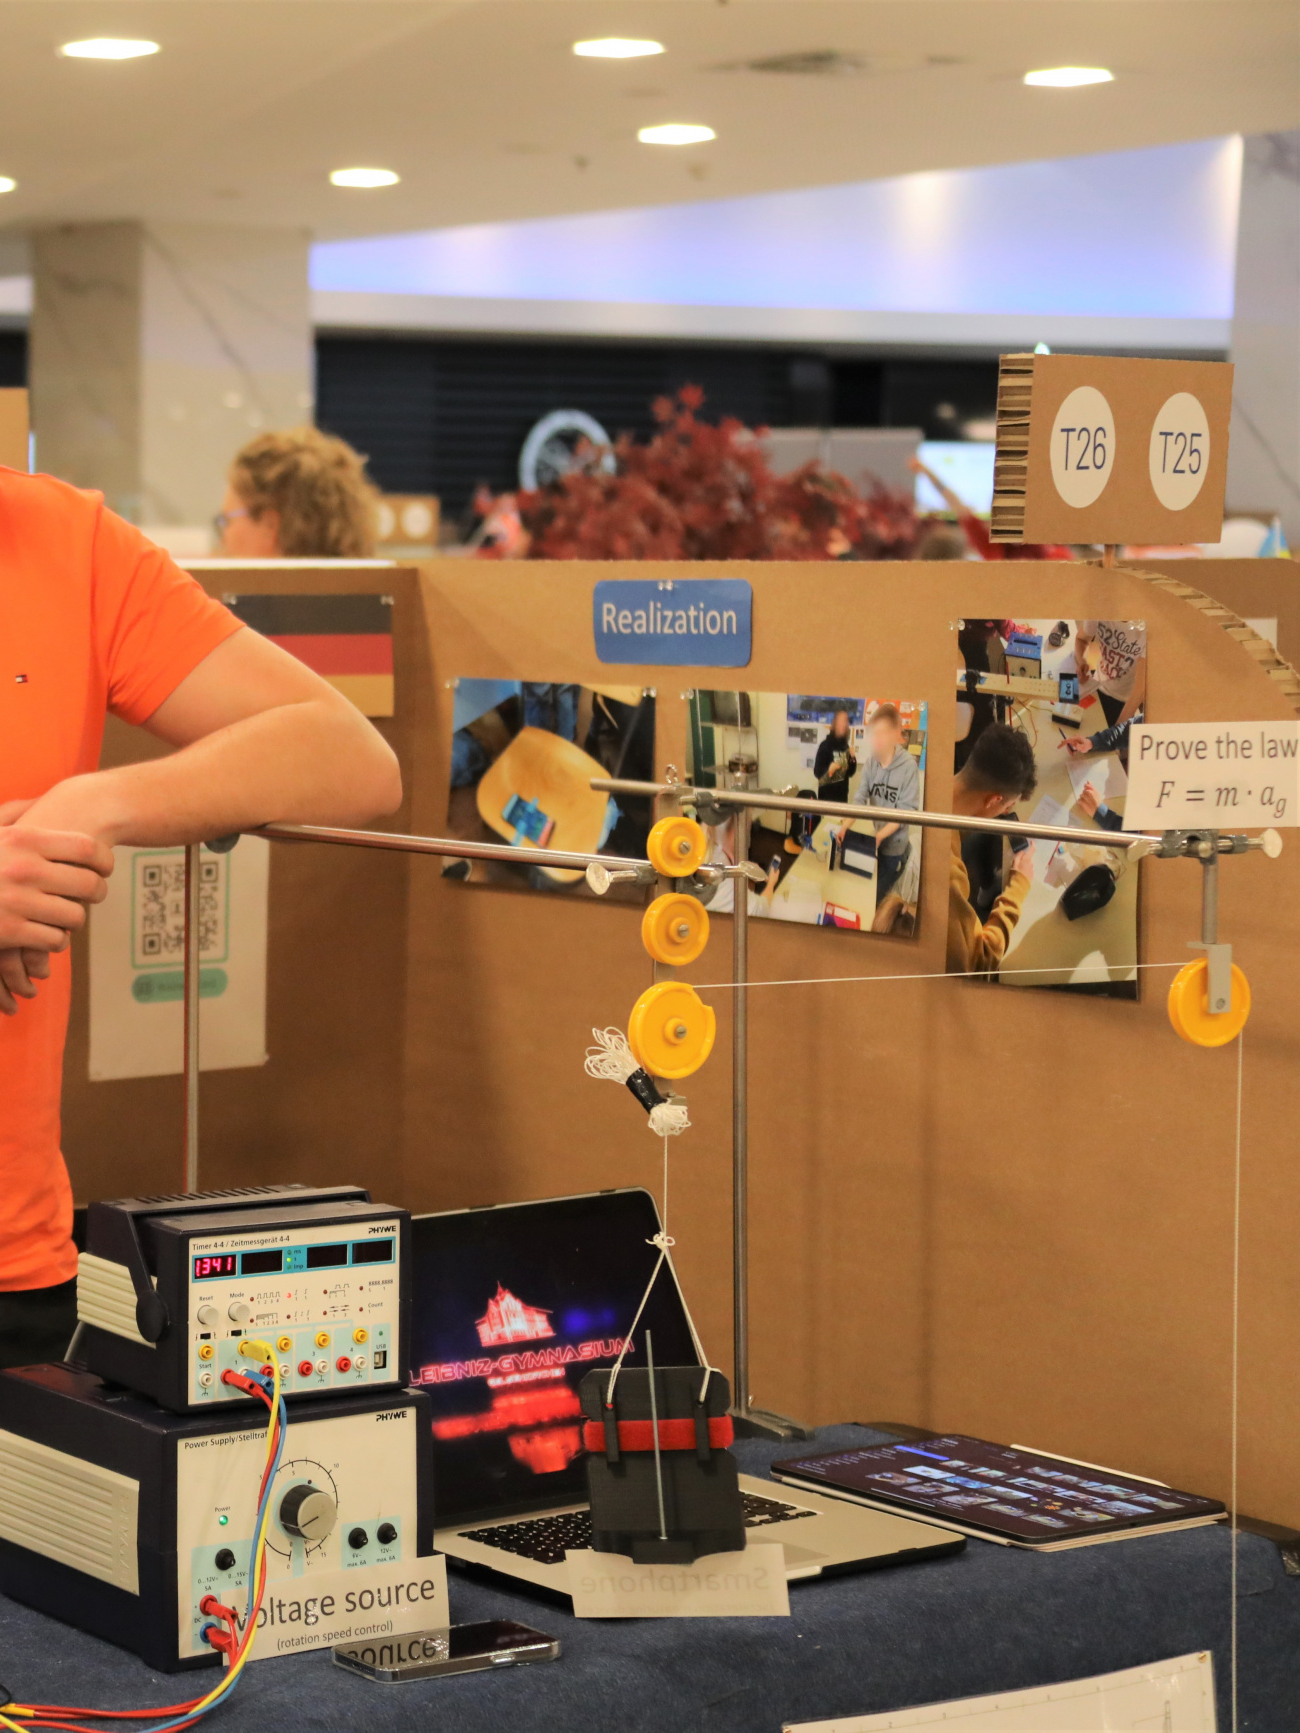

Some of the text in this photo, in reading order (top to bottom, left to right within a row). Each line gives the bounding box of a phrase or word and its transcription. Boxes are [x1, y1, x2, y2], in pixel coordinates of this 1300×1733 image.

[1060, 427, 1107, 471] T26
[1159, 431, 1203, 475] T25
[602, 600, 737, 635] Realization
[1139, 731, 1300, 761] Prove the law
[867, 784, 899, 803] VANS
[1155, 780, 1176, 809] F
[1215, 786, 1240, 807] m
[192, 1242, 212, 1251] Timer
[213, 1241, 225, 1249] 4-4
[230, 1236, 278, 1248] Zeitmessgerät
[279, 1235, 290, 1243] 4-4
[368, 1225, 397, 1235] PHYWE
[409, 1337, 636, 1387] LEIBNIZ-GYMNASIUM
[375, 1410, 408, 1422] PHYWE
[184, 1430, 269, 1450] Power Supply/Stelltraf
[214, 1505, 231, 1513] Power
[344, 1579, 436, 1613] source
[277, 1620, 393, 1651] (rotation speed control)
